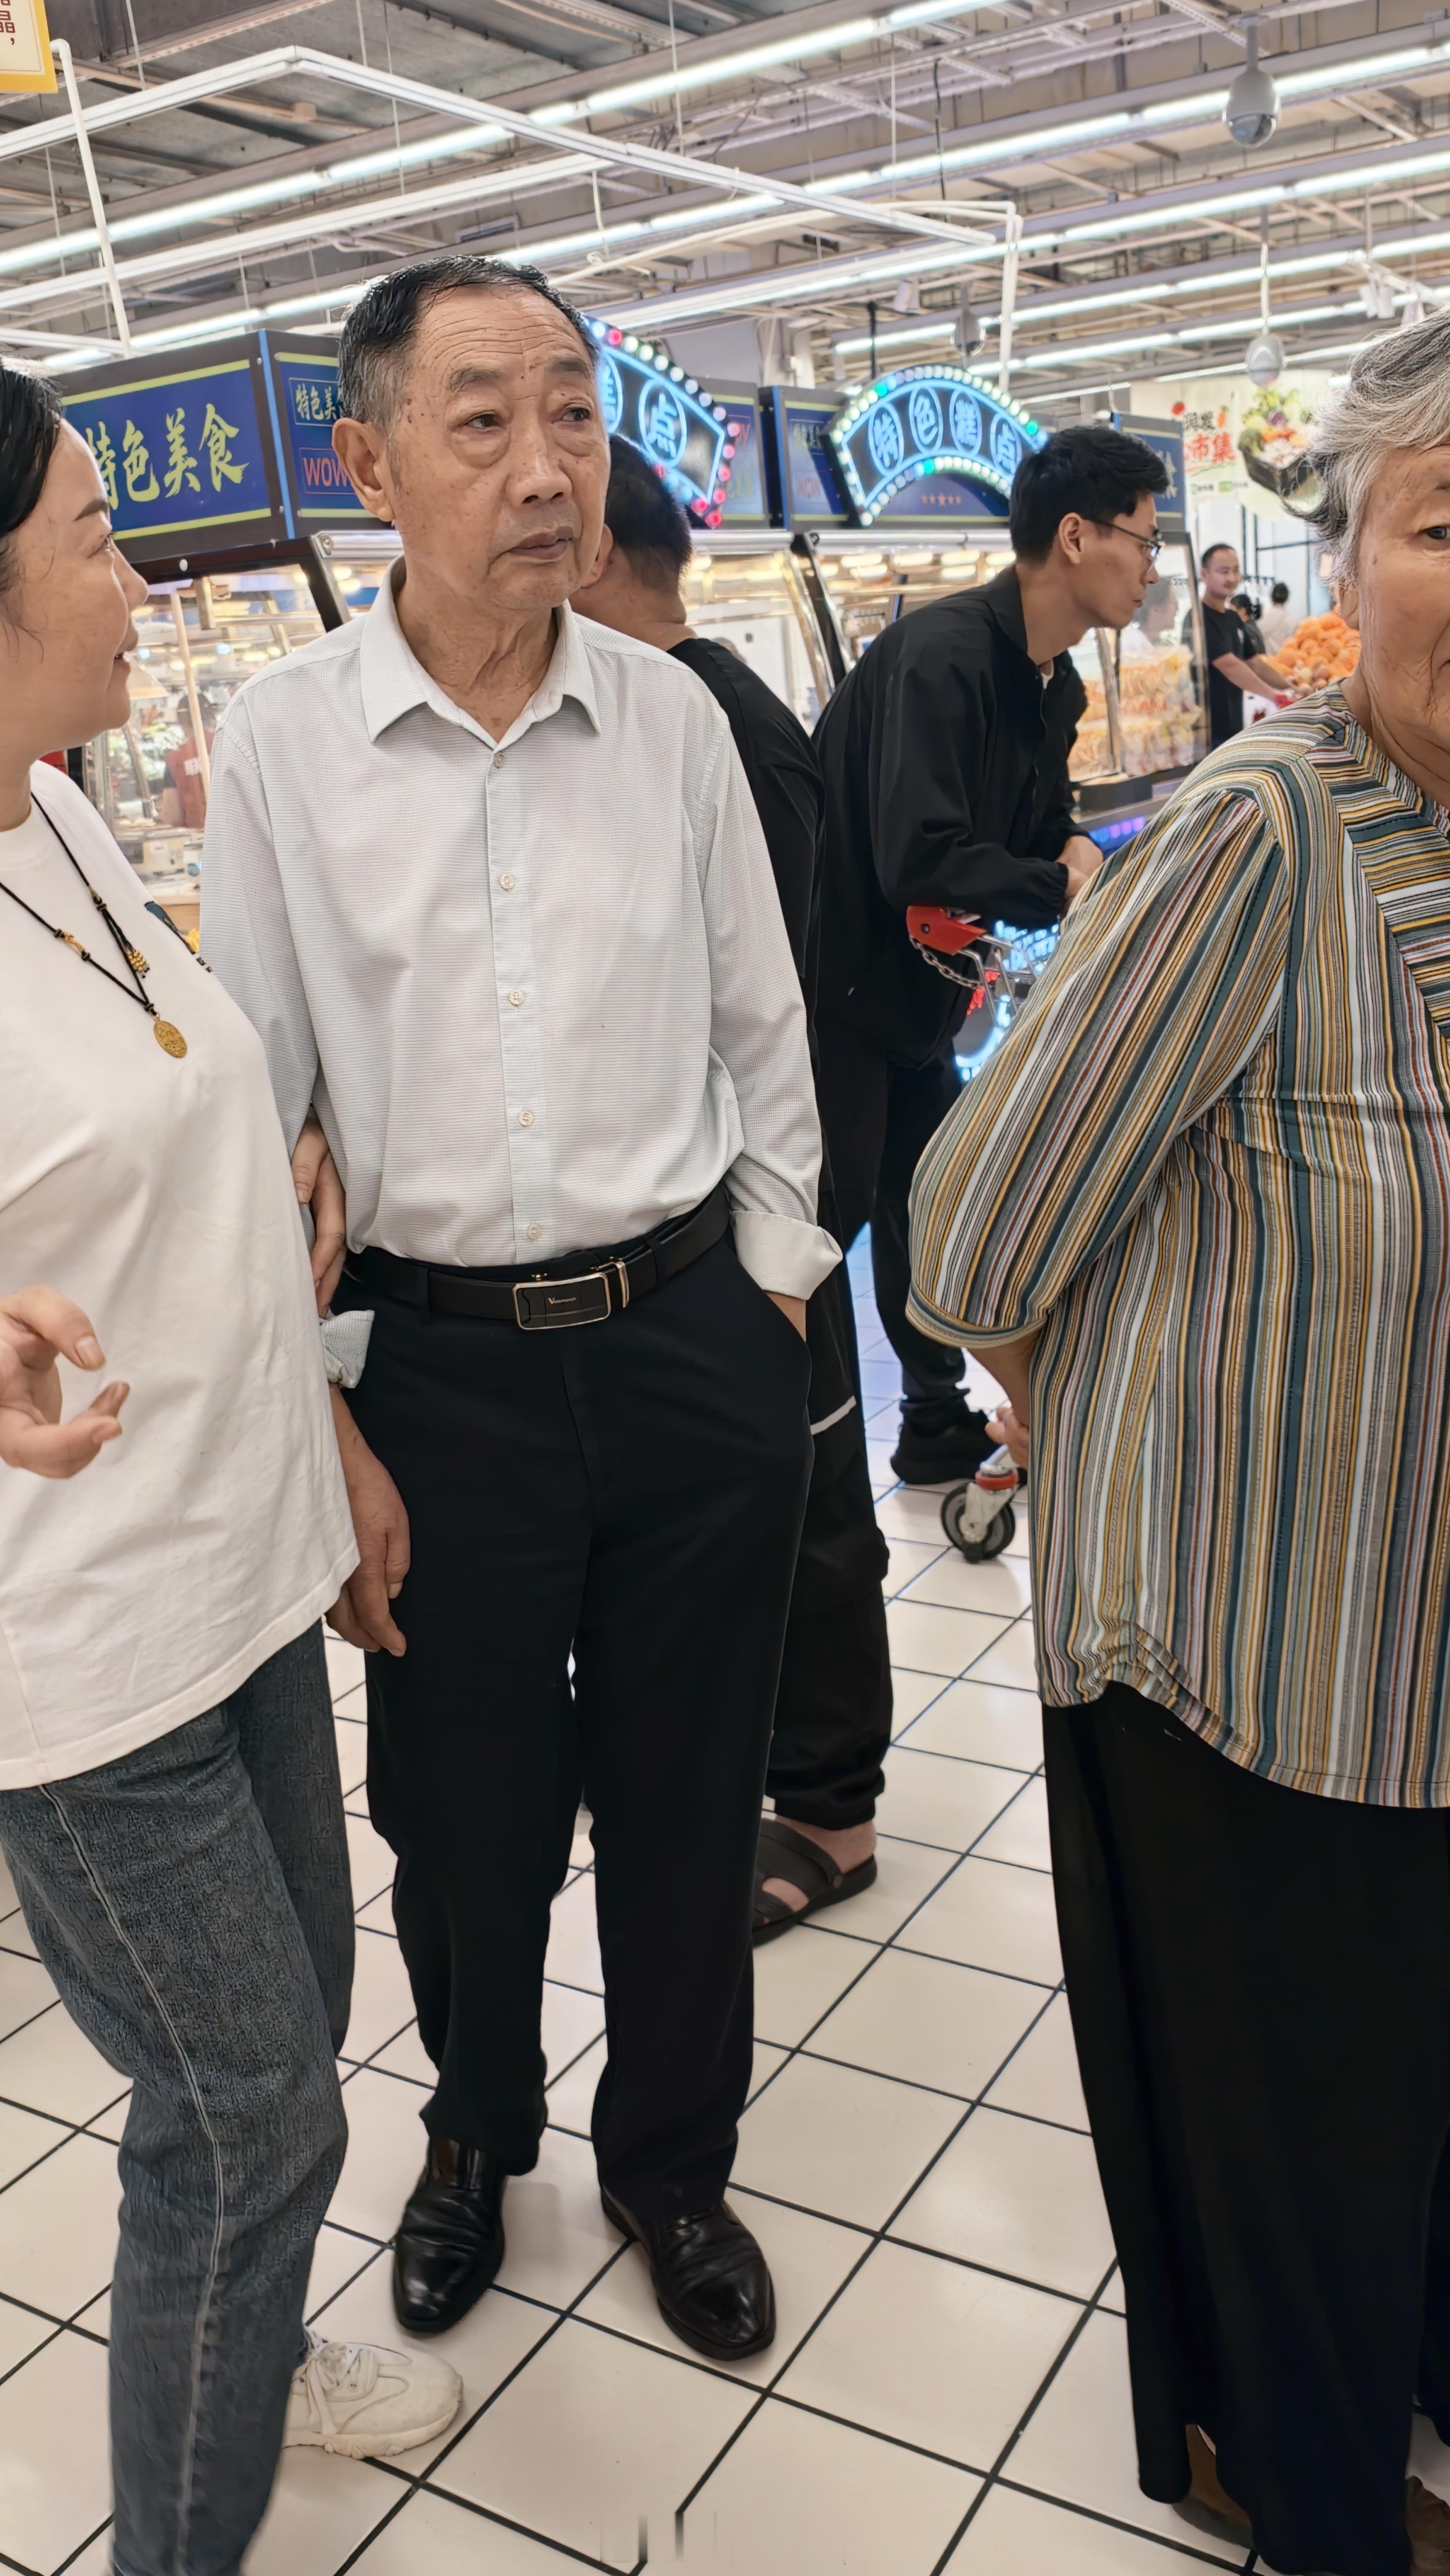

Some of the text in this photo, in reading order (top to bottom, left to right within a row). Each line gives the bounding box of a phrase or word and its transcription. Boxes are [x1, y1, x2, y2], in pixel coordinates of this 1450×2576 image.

[296, 383, 342, 420] 特色美
[86, 402, 249, 510] 特色美食
[1185, 432, 1236, 464] 市集
[303, 457, 350, 487] WOW
